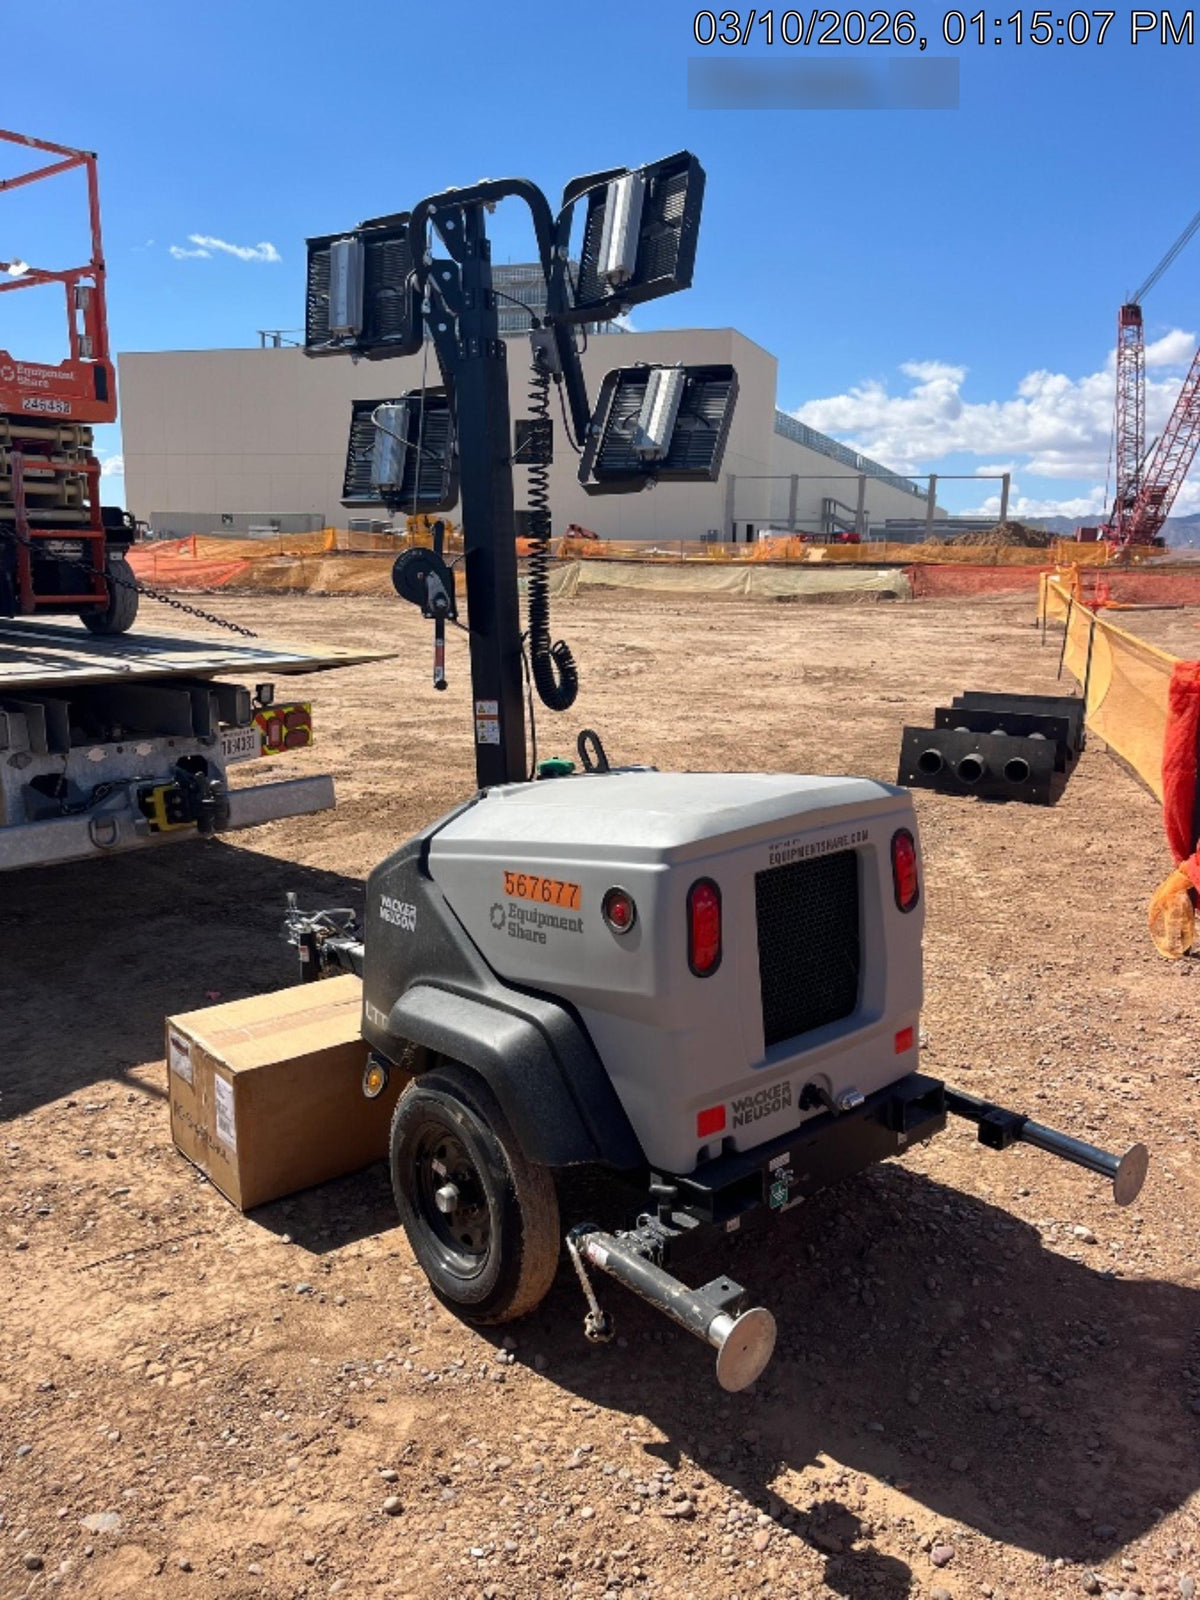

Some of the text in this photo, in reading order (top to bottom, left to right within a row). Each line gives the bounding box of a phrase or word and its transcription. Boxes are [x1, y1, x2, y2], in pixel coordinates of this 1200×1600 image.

[769, 829, 869, 866] EQUIPMENTSHARE.COM
[504, 870, 579, 908] 567677
[508, 902, 584, 934] Equipment
[508, 921, 547, 945] Share
[731, 1080, 791, 1114] WACKER
[732, 1093, 792, 1129] NEUSON
